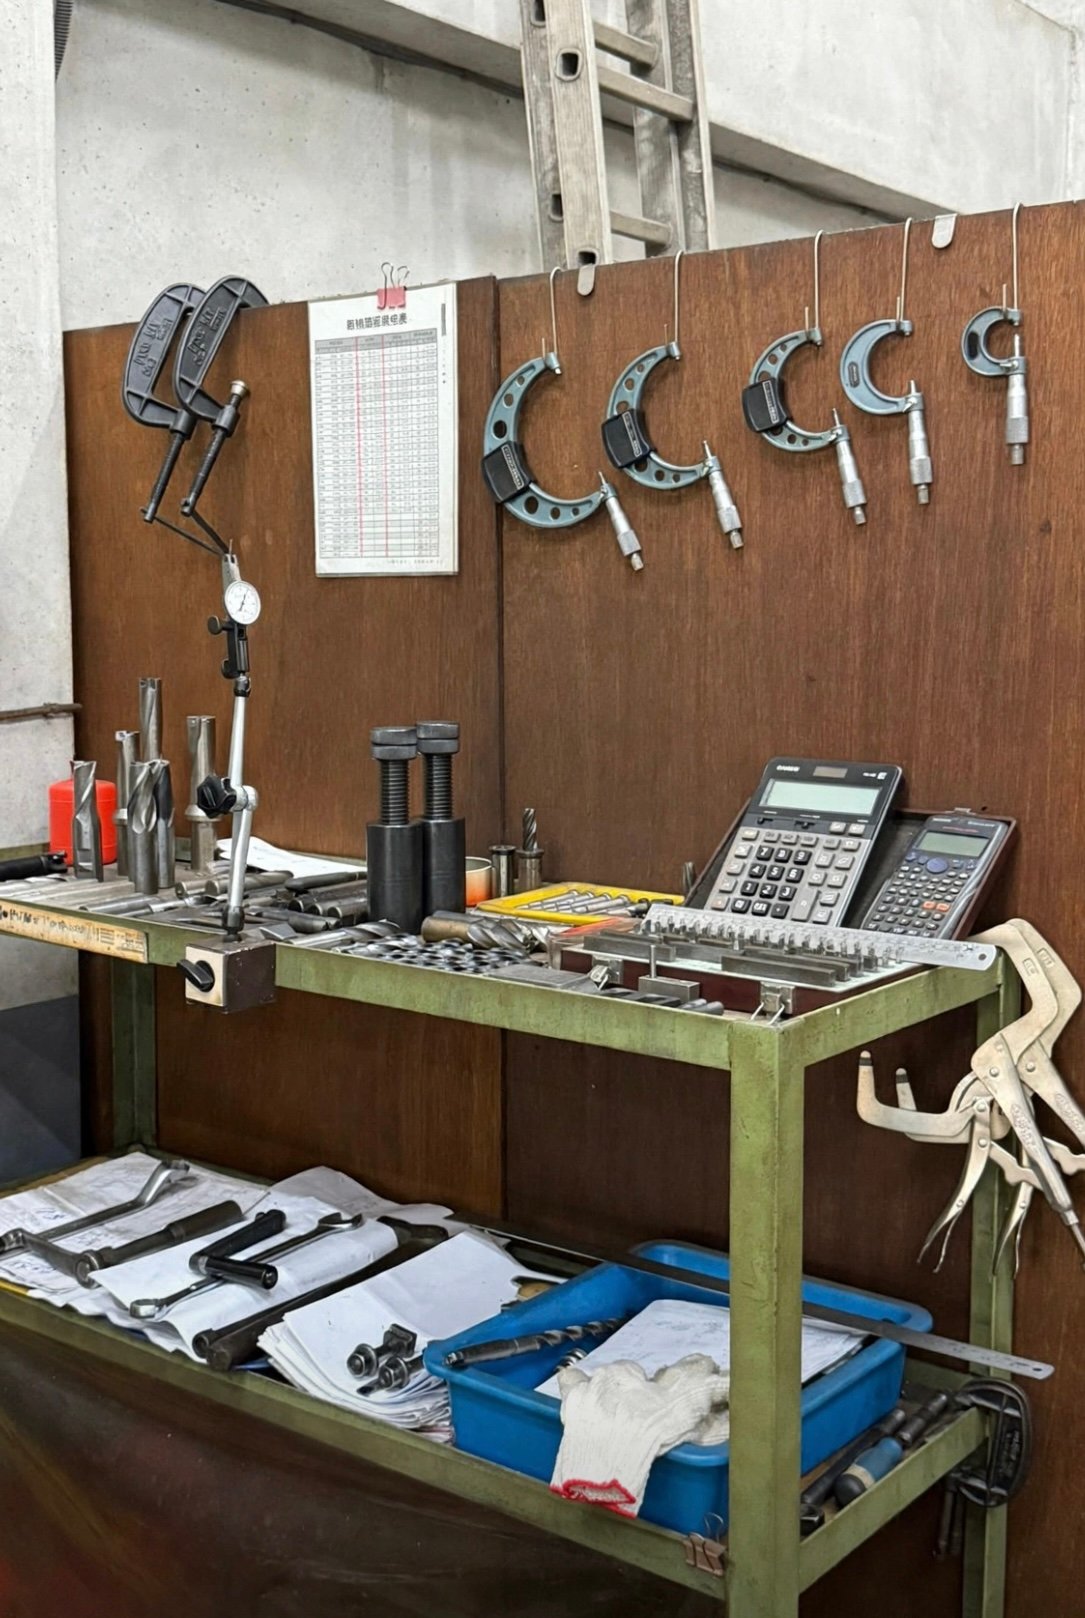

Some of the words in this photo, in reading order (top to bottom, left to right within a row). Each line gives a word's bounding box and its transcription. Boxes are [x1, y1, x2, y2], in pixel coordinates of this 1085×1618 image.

[760, 847, 768, 856] 7
[797, 851, 805, 860] 9
[771, 867, 779, 876] 5
[746, 882, 752, 891] 1
[762, 885, 771, 894] 2
[782, 886, 791, 896] 3
